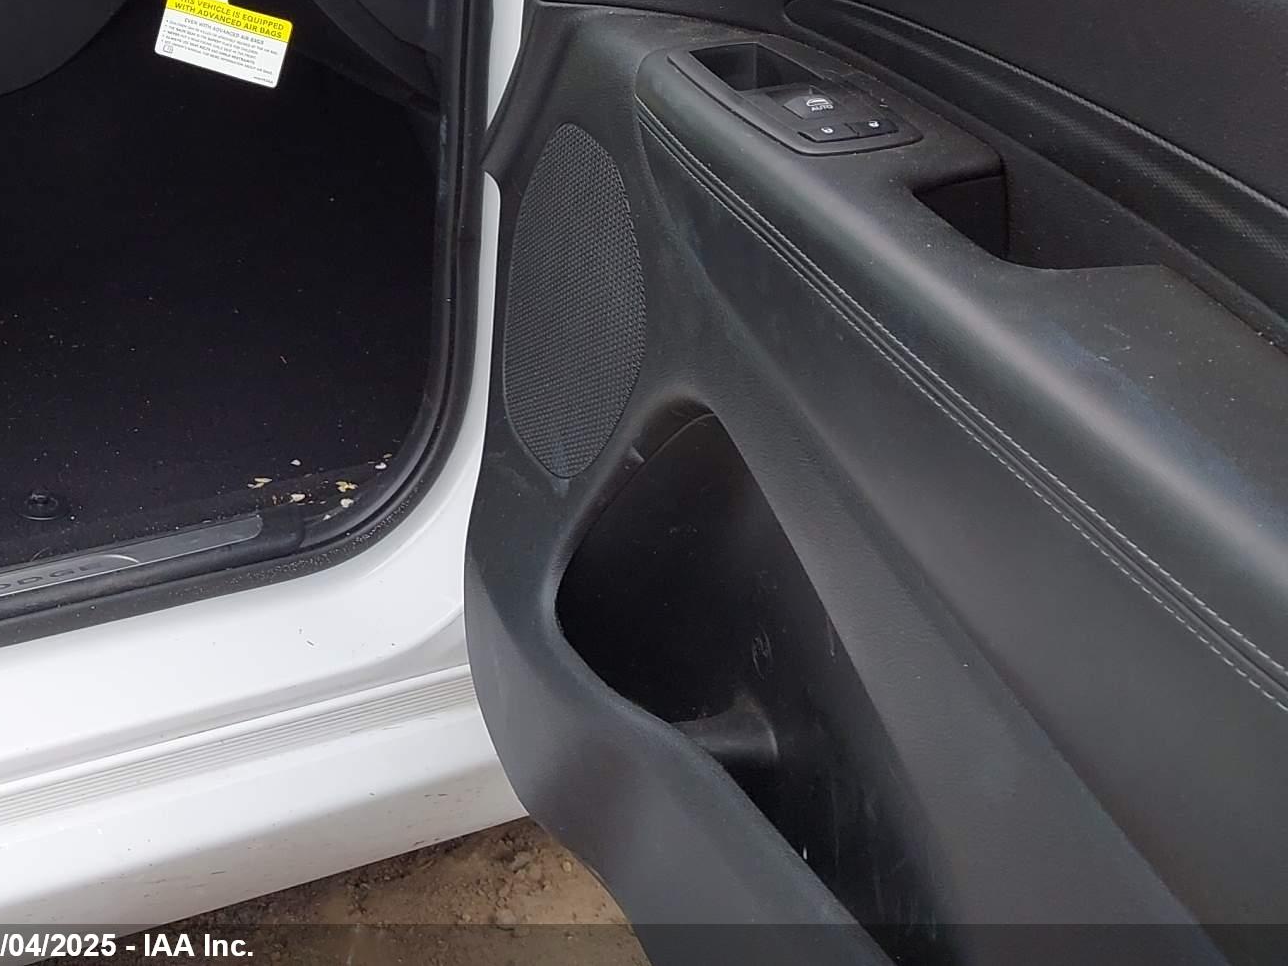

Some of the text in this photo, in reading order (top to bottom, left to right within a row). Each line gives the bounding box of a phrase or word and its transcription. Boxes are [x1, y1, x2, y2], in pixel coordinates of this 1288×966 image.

[174, 2, 282, 38] WITH ADVANCED AIR BAGS
[196, 0, 231, 15] VEHICLE
[232, 10, 240, 18] IS
[241, 13, 284, 30] EQUIPPED
